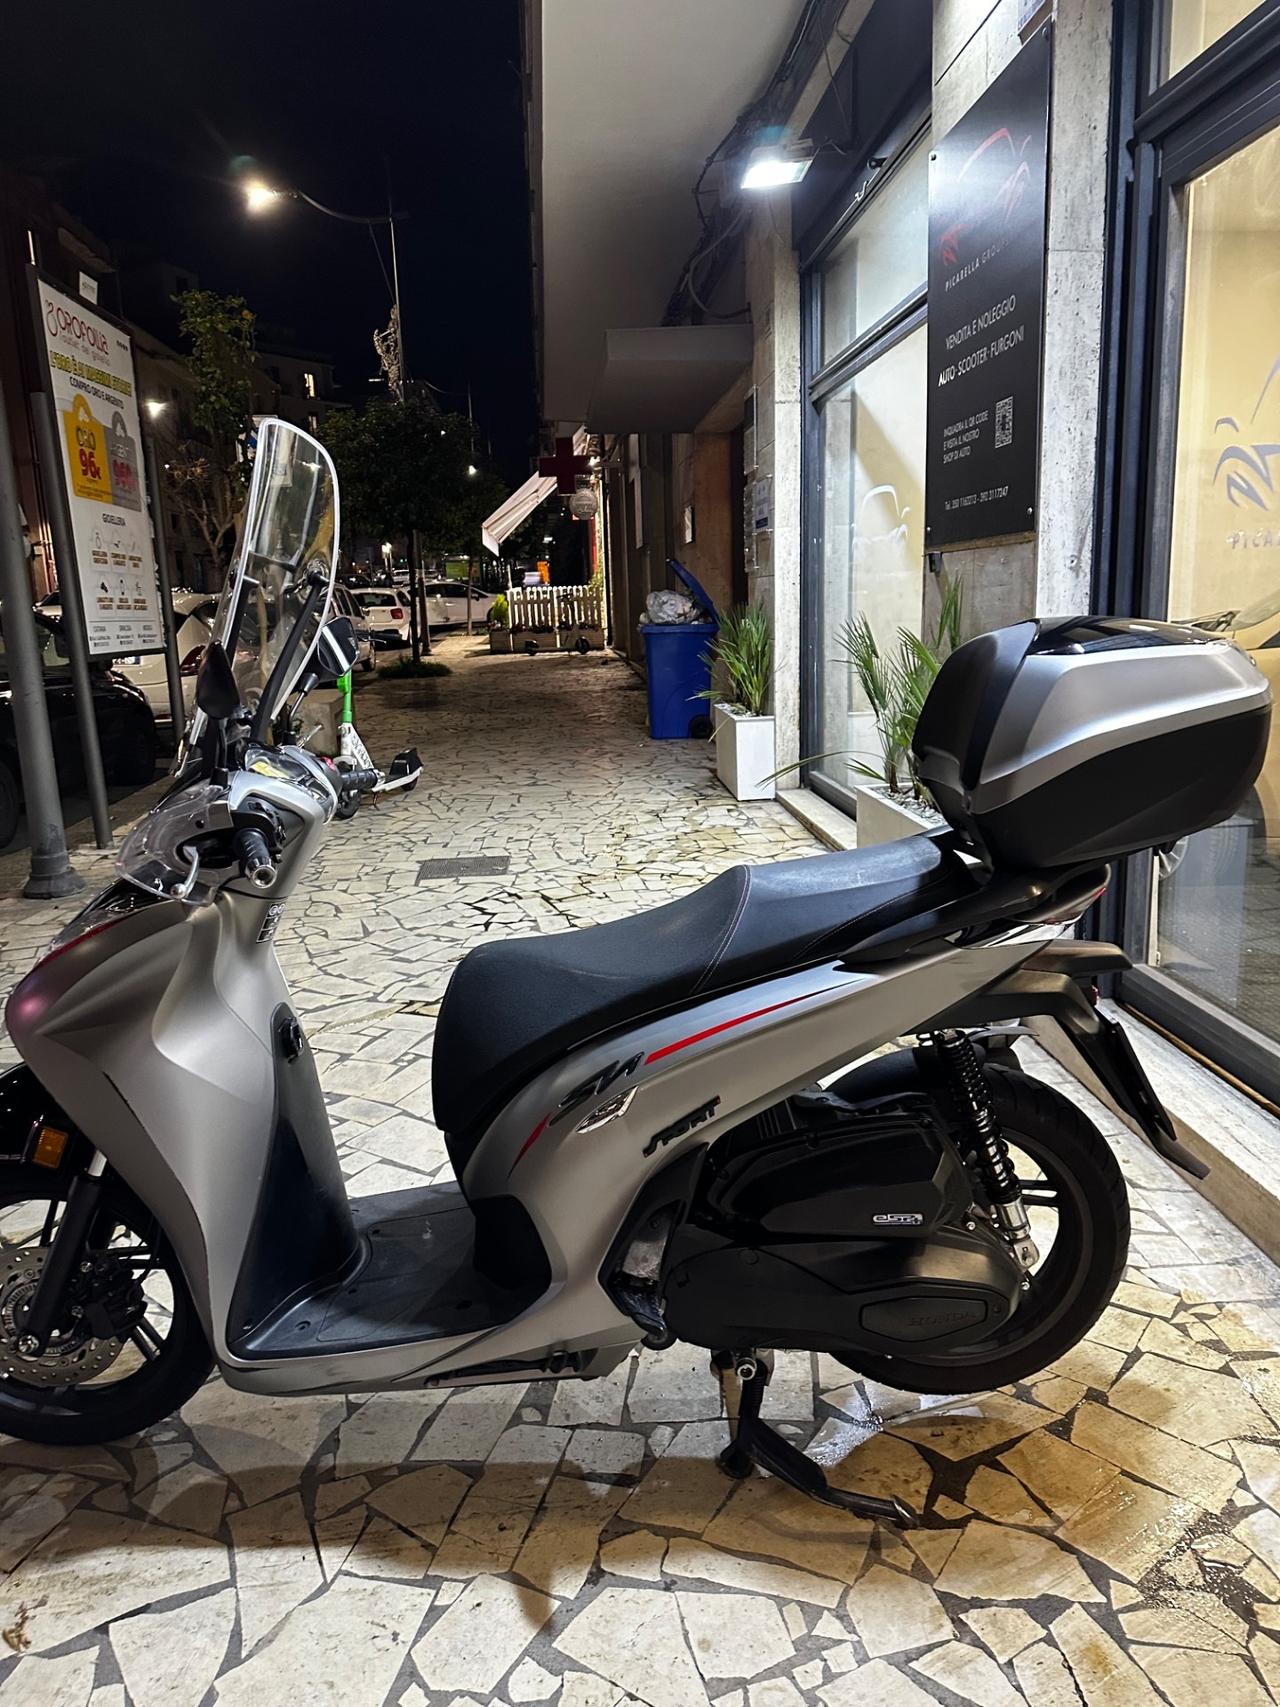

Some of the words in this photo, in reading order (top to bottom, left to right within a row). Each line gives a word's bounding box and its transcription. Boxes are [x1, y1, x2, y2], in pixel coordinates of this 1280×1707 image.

[945, 257, 980, 292] PICARELLA
[945, 324, 971, 349] VENDITA
[972, 319, 977, 335] E
[977, 294, 1016, 331] NOLEGGIO
[938, 365, 955, 387] AUTO
[958, 347, 987, 376] SCOOTER
[990, 324, 1024, 358] FURGONI
[75, 425, 97, 451] ORO
[975, 410, 988, 424] CODE
[642, 1095, 721, 1158] SPORT
